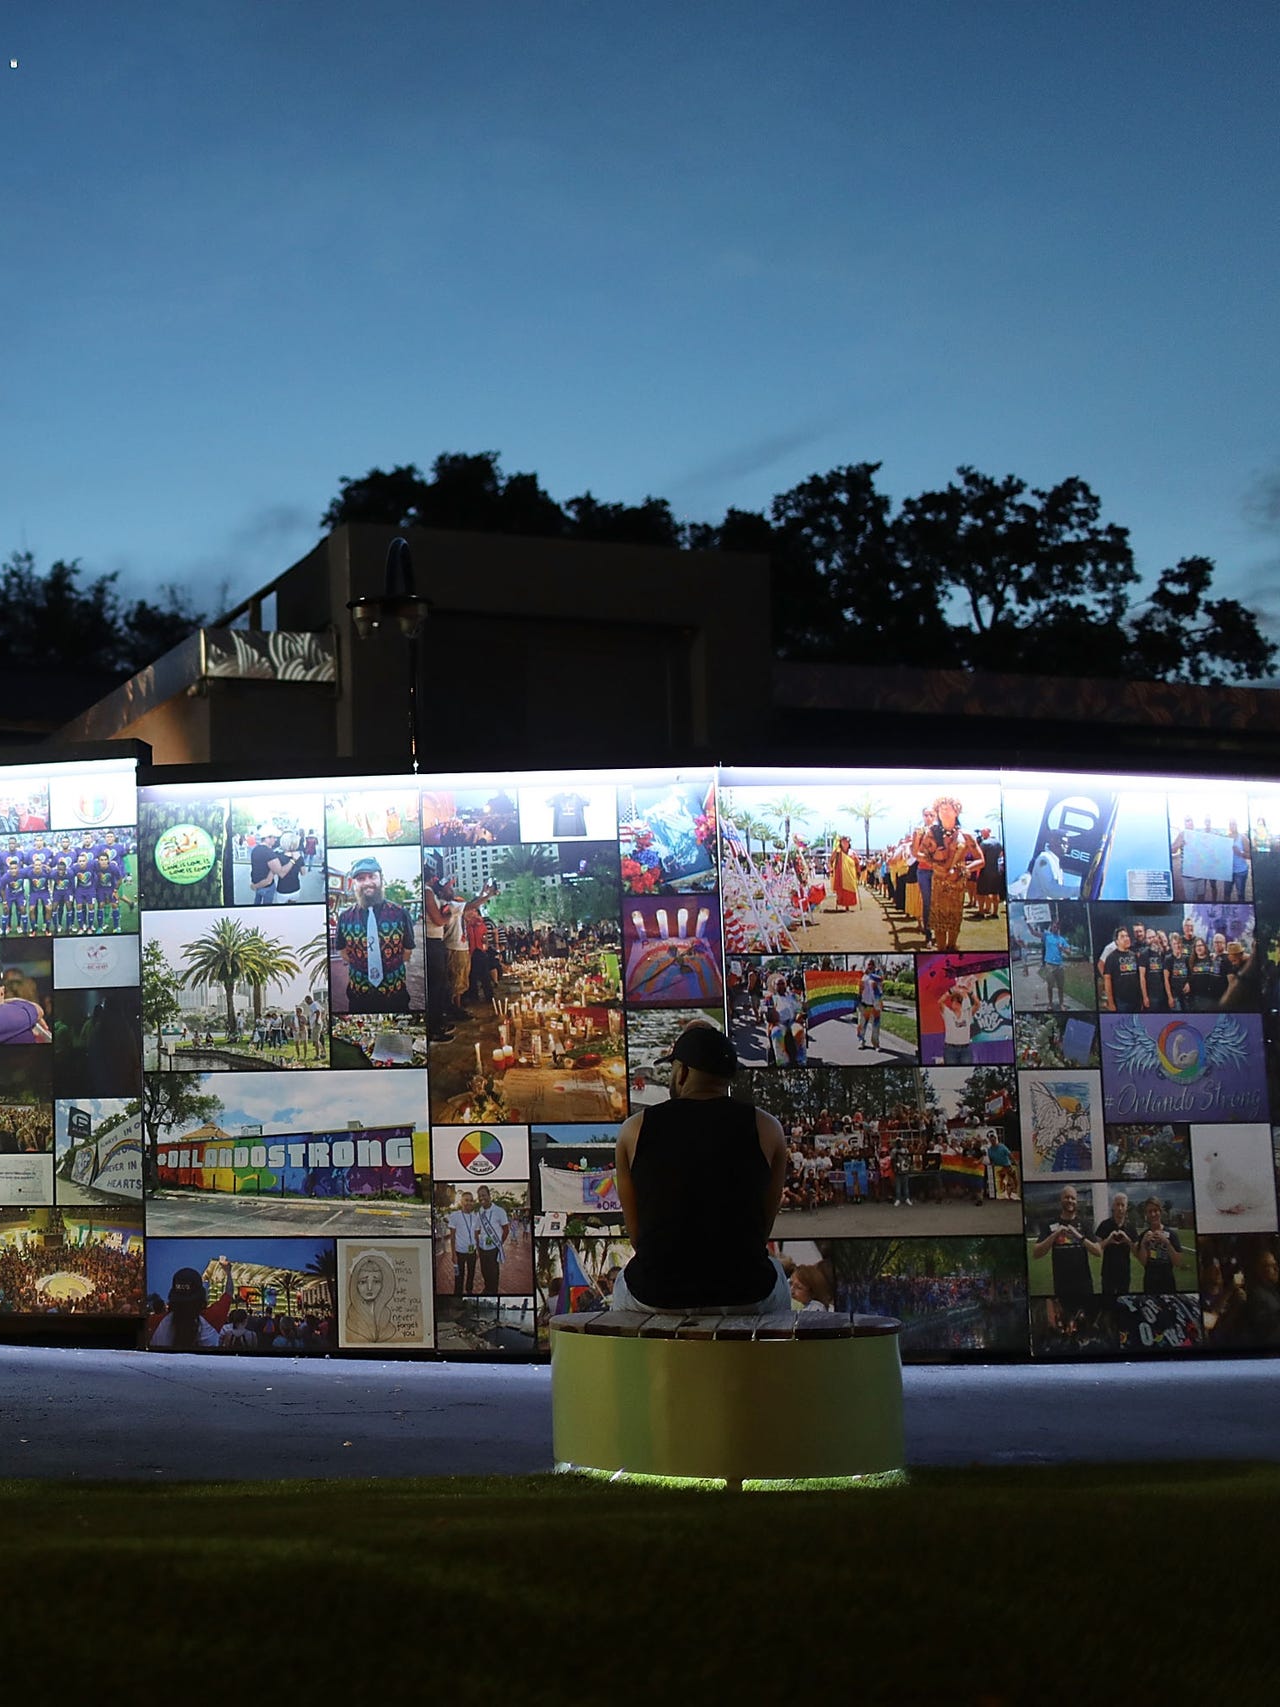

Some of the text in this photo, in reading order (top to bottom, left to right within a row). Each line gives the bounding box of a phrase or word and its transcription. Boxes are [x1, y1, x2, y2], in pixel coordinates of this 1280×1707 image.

[123, 1126, 132, 1136] IN
[157, 1137, 413, 1169] #ORLANDOSTRONG
[128, 1160, 137, 1170] IN
[107, 1179, 142, 1190] HEARTS
